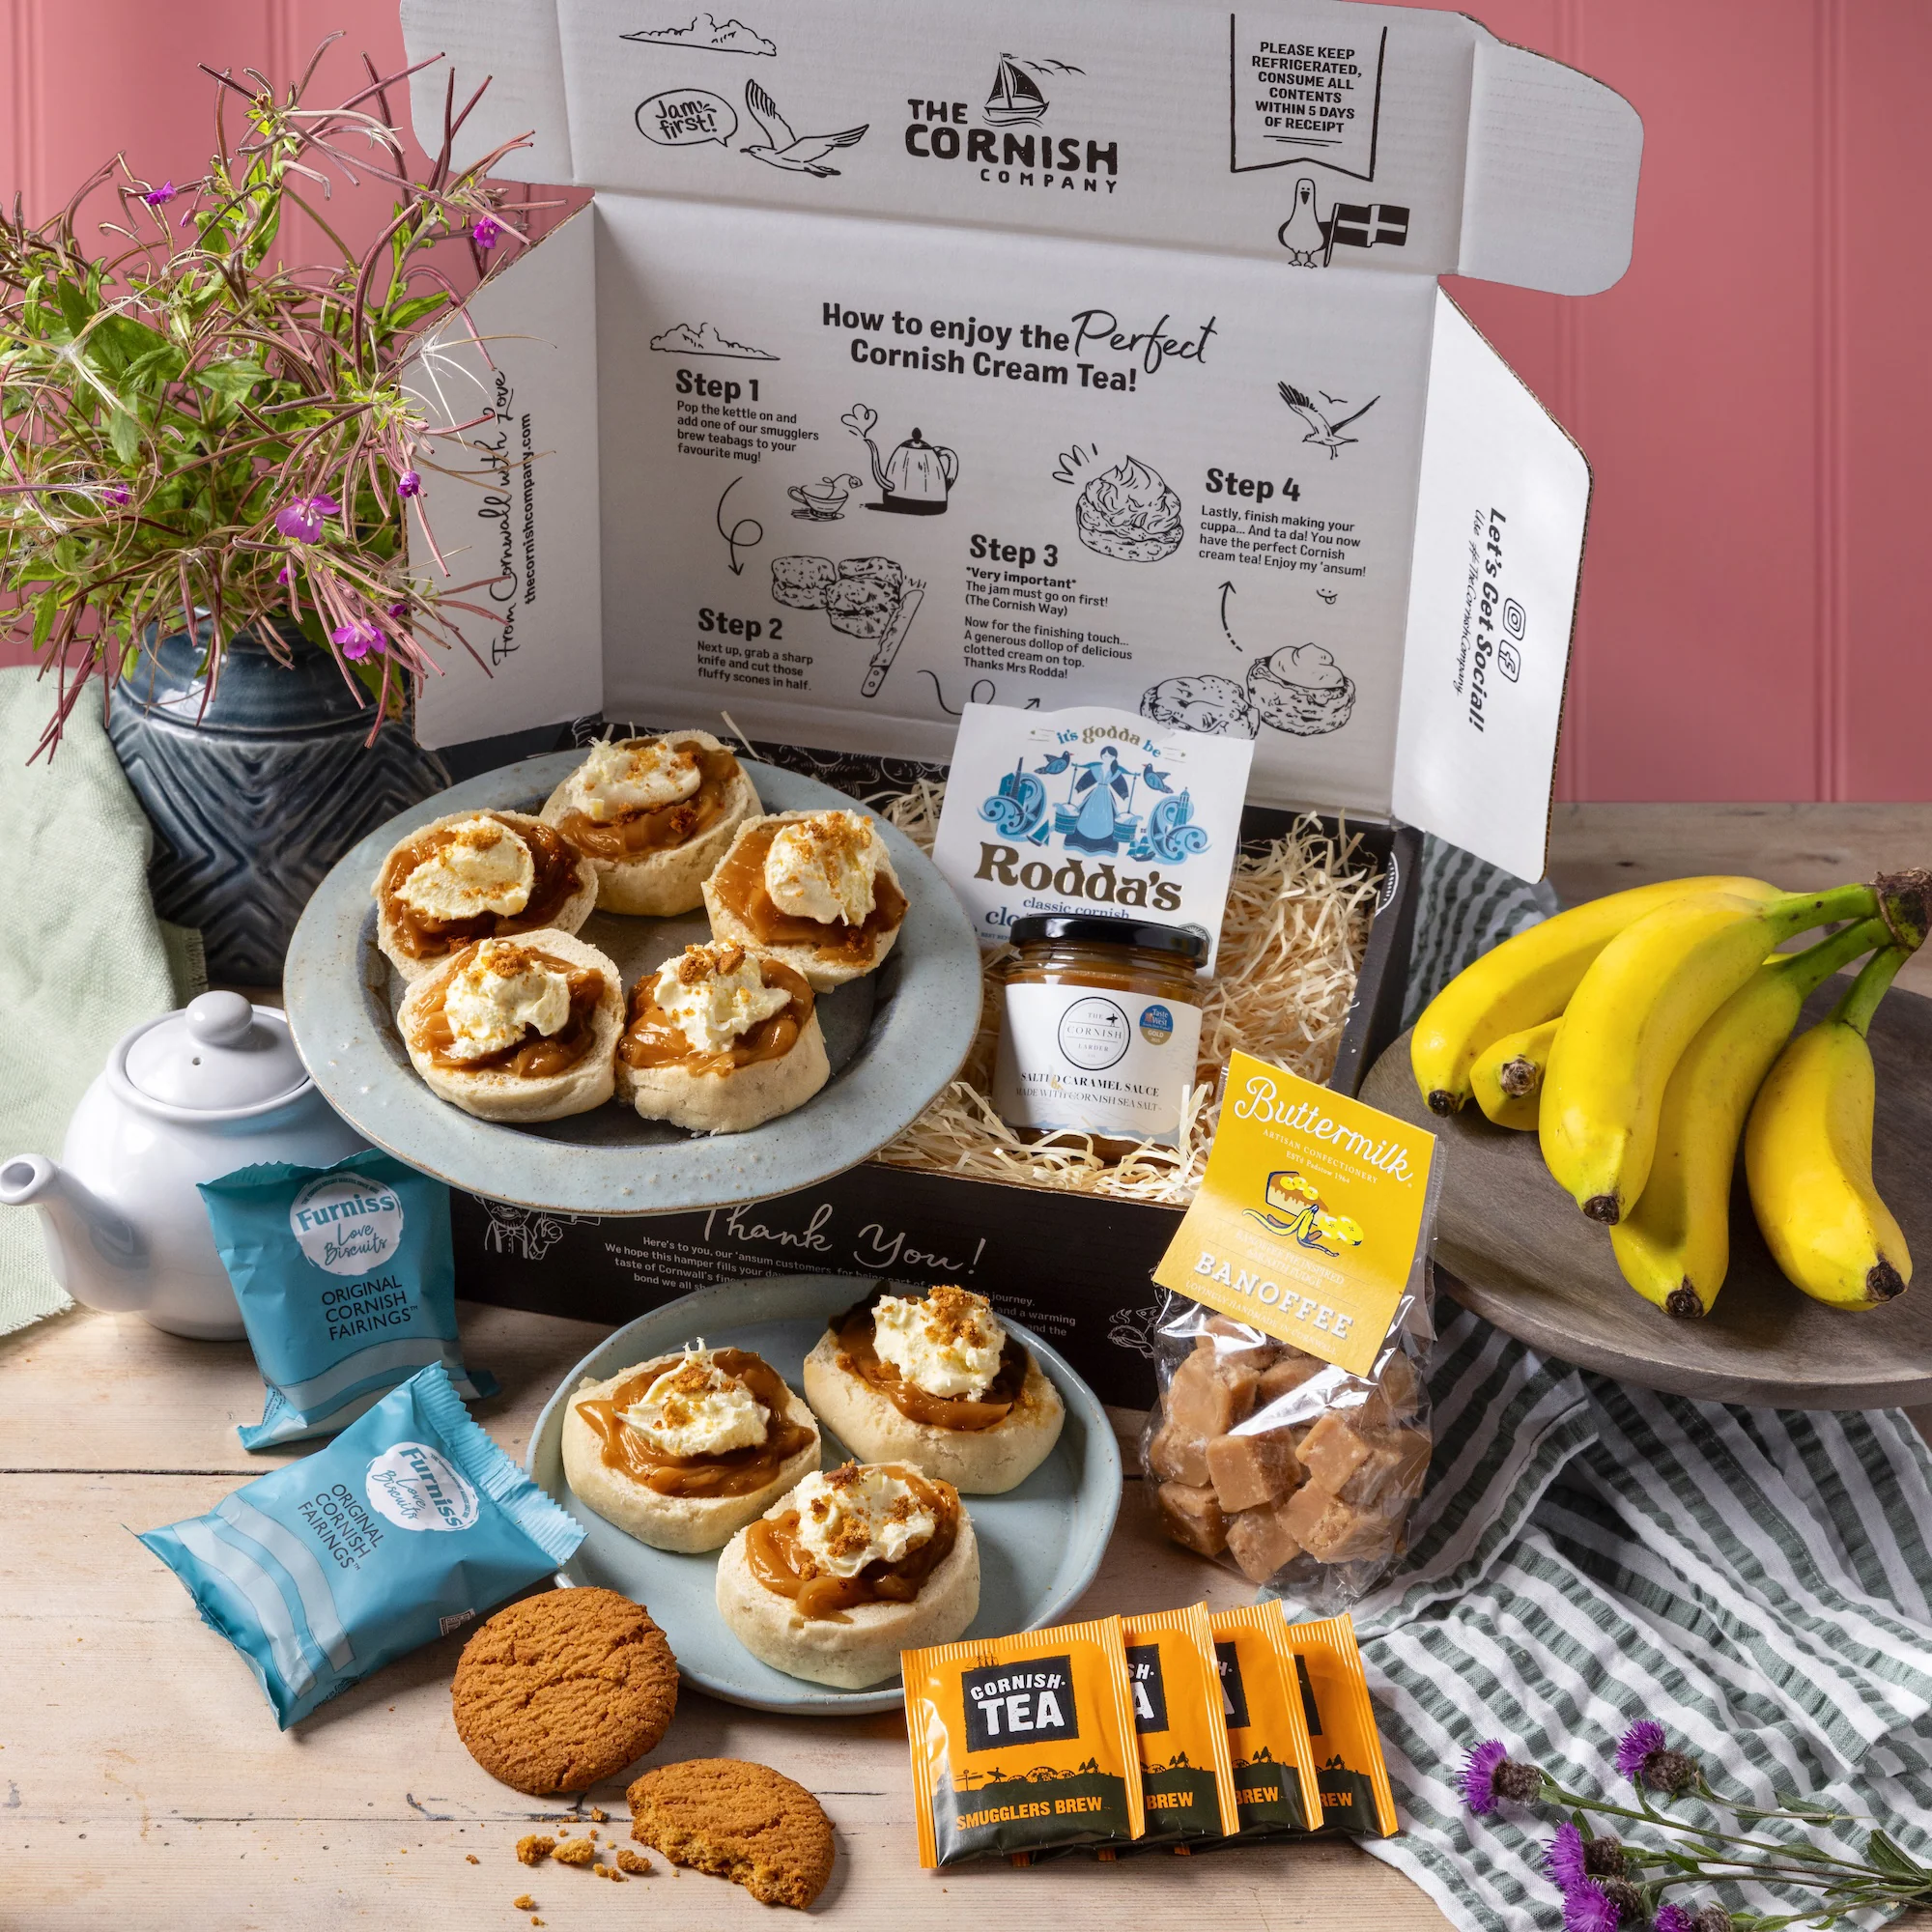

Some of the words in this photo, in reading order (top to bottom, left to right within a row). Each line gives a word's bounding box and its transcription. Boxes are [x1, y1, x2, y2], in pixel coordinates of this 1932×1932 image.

[1261, 42, 1315, 57] PLEASE
[1318, 47, 1354, 59] KEEP
[1252, 56, 1362, 77] REFRIGERATED,
[1259, 71, 1323, 87] CONSUME
[1327, 77, 1354, 90] ALL
[1269, 88, 1341, 102] CONTENTS
[654, 99, 703, 121] Jam
[907, 99, 968, 124] THE
[1256, 101, 1304, 115] WITHIN
[1309, 106, 1316, 116] 5
[1320, 107, 1354, 119] DAYS
[1264, 116, 1282, 127] OF
[1286, 119, 1344, 132] RECEIPT
[660, 113, 717, 139] first!
[906, 126, 1118, 175] CORNISH
[980, 169, 1117, 193] COMPANY
[822, 302, 885, 331] How
[893, 312, 923, 335] to
[930, 315, 1012, 352] enjoy
[1021, 324, 1070, 353] the
[1072, 309, 1217, 373] Perfect
[851, 339, 966, 375] Cornish
[973, 357, 1068, 385] Cream
[1077, 363, 1137, 392] Tea!
[676, 369, 741, 403] Step
[749, 380, 758, 402] 1
[677, 401, 697, 414] Pop
[701, 405, 720, 414] the
[724, 407, 756, 419] kettle
[760, 412, 773, 421] on
[777, 414, 796, 424] and
[677, 416, 697, 426] add
[701, 420, 721, 429] one
[724, 422, 735, 431] of
[739, 424, 757, 433] our
[761, 427, 819, 440] smugglers
[677, 429, 704, 441] brew
[708, 432, 753, 448] teabags
[756, 438, 768, 448] to
[772, 442, 796, 452] your
[678, 443, 730, 458] favourite
[733, 449, 761, 464] mug!
[1206, 469, 1273, 503] Step
[1283, 477, 1300, 501] 4
[1202, 505, 1241, 521] Lastly,
[1245, 510, 1278, 523] finish
[1282, 515, 1324, 530] making
[1328, 521, 1354, 532] your
[478, 494, 518, 602] Cornwall
[1200, 534, 1228, 546] have
[1231, 537, 1250, 549] the
[1253, 540, 1297, 554] perfect
[1300, 545, 1345, 559] Cornish
[1201, 522, 1245, 534] cuppa...
[1248, 525, 1270, 537] And
[1274, 528, 1287, 538] ta
[1290, 529, 1307, 541] da!
[1311, 532, 1333, 544] You
[1336, 537, 1360, 547] now
[1486, 507, 1506, 578] Let's
[970, 534, 1036, 568] Step
[1043, 544, 1058, 567] 3
[1199, 550, 1236, 561] cream
[1239, 553, 1261, 564] tea!
[1264, 555, 1296, 570] Enjoy
[1300, 561, 1317, 573] my
[966, 581, 986, 592] The
[988, 583, 1010, 595] jam
[1013, 589, 1042, 599] must
[1045, 593, 1059, 602] go
[1063, 594, 1075, 603] on
[1079, 593, 1108, 607] first!
[966, 594, 989, 607] (The
[993, 598, 1036, 612] Cornish
[1038, 604, 1067, 617] Way)
[1479, 582, 1498, 632] Get
[492, 603, 520, 666] From
[698, 608, 761, 641] Step
[770, 618, 781, 640] 2
[965, 616, 988, 628] Now
[992, 619, 1009, 631] for
[1012, 622, 1031, 633] the
[1035, 624, 1084, 642] finishing
[1088, 631, 1128, 645] touch...
[697, 640, 723, 653] Next
[725, 646, 742, 657] up,
[745, 648, 770, 659] grab
[782, 652, 813, 666] sharp
[964, 630, 972, 639] A
[975, 632, 1026, 646] generous
[1029, 638, 1064, 652] dollop
[1066, 642, 1079, 653] of
[1082, 644, 1132, 660] delicious
[964, 644, 1005, 657] clotted
[1008, 650, 1042, 662] cream
[1064, 656, 1085, 668] top.
[697, 654, 725, 667] knife
[729, 660, 748, 669] and
[752, 663, 769, 672] cut
[773, 664, 803, 676] those
[964, 656, 1004, 670] Thanks
[1007, 663, 1026, 673] Mrs
[1029, 666, 1067, 678] Rodda!
[698, 668, 730, 682] fluffy
[733, 673, 771, 686] scones
[773, 677, 782, 687] in
[786, 679, 811, 691] half.
[1468, 633, 1492, 732] Social!
[1056, 729, 1078, 745] it's
[1143, 740, 1161, 758] be
[974, 841, 1183, 911] Rodda's
[1023, 897, 1070, 914] classic
[1075, 905, 1129, 919] cornish
[1067, 1027, 1122, 1038] CORNISH
[1064, 1076, 1122, 1091] CARAMEL
[1124, 1084, 1159, 1096] SAUCE
[1235, 1076, 1413, 1181] Buttermilk
[1263, 1129, 1301, 1150] ARTISAN
[1304, 1147, 1378, 1183] CONFECTIONERY
[1307, 1159, 1332, 1176] Padstow
[1335, 1173, 1350, 1183] 1964
[296, 1194, 395, 1232] Furniss
[338, 1223, 374, 1246] Love
[325, 1233, 387, 1265] Biscuits
[605, 1243, 621, 1253] We
[624, 1246, 649, 1261] hope
[652, 1251, 671, 1263] this
[674, 1254, 713, 1269] hamper
[717, 1261, 737, 1272] fills
[739, 1265, 763, 1278] your
[854, 1224, 986, 1275] You!
[322, 1275, 402, 1306] ORIGINAL
[1194, 1252, 1352, 1339] BANOFFEE
[326, 1292, 406, 1323] CORNISH
[396, 1478, 426, 1509] Love
[399, 1447, 463, 1527] Furniss
[316, 1493, 370, 1558] CORNISH
[331, 1485, 384, 1548] ORIGINAL
[978, 1691, 1064, 1736] TEA
[956, 1801, 1051, 1832] SMUGGLERS
[1056, 1796, 1102, 1814] BREW
[1147, 1792, 1193, 1809] BREW
